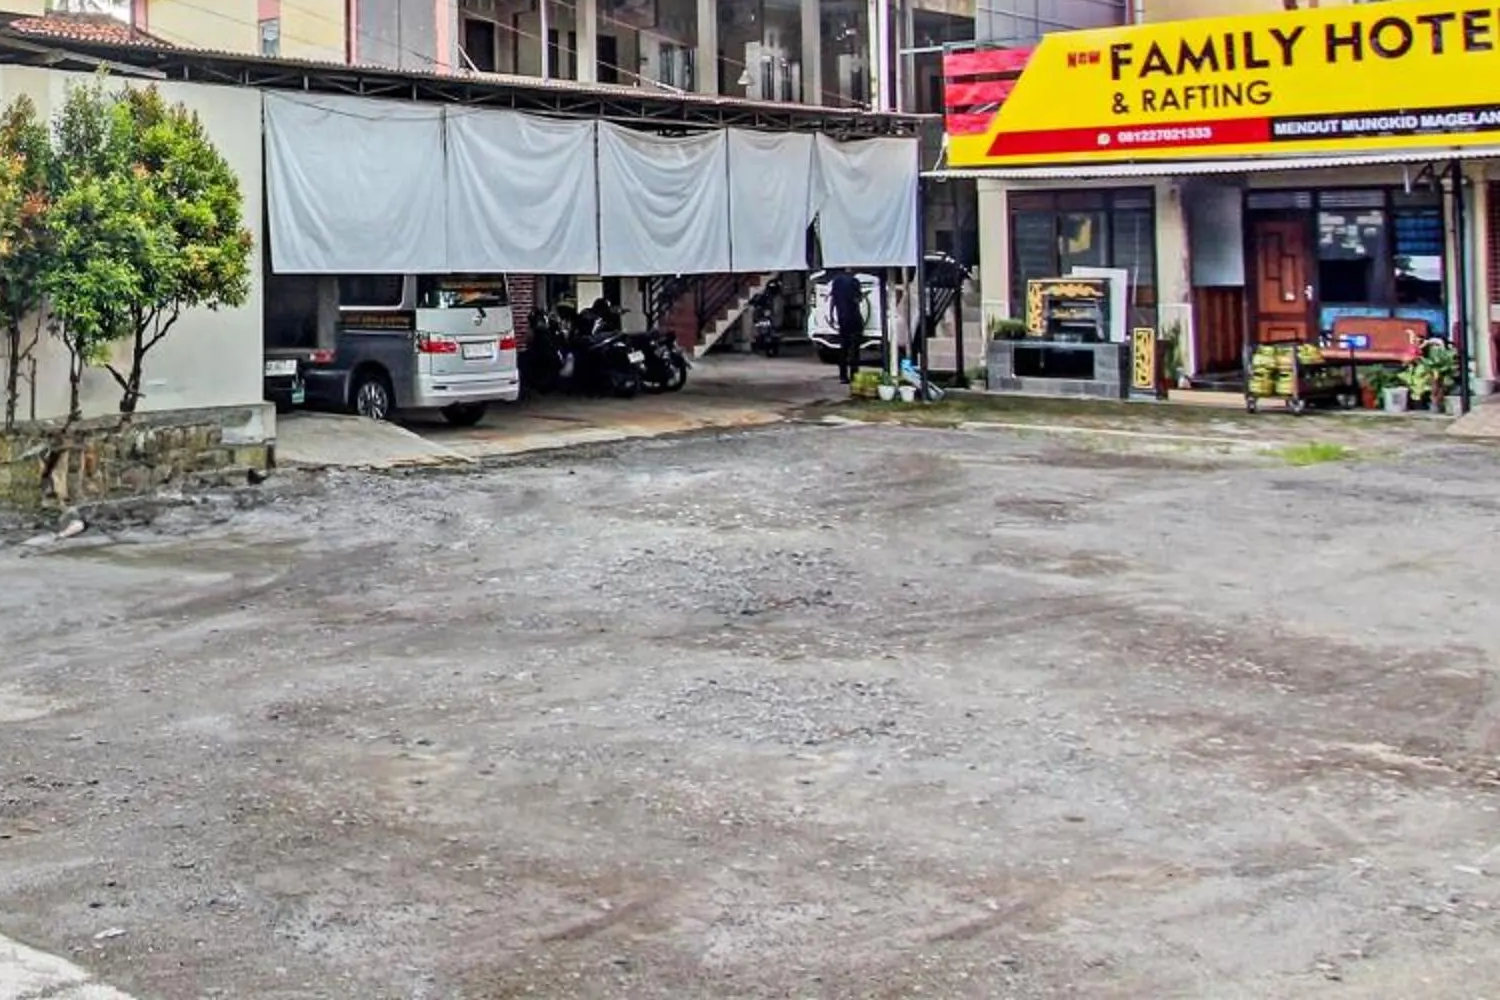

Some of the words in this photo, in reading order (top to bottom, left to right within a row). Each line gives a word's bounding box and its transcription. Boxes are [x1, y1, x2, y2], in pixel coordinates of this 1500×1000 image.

[1110, 26, 1306, 81] FAMILY
[1324, 7, 1500, 64] HOTE
[1111, 91, 1130, 115] &
[1141, 80, 1273, 113] RAFTING
[1274, 119, 1339, 136] MENDUT
[1341, 114, 1418, 132] MUNGKID
[1420, 110, 1500, 128] MAGELAN
